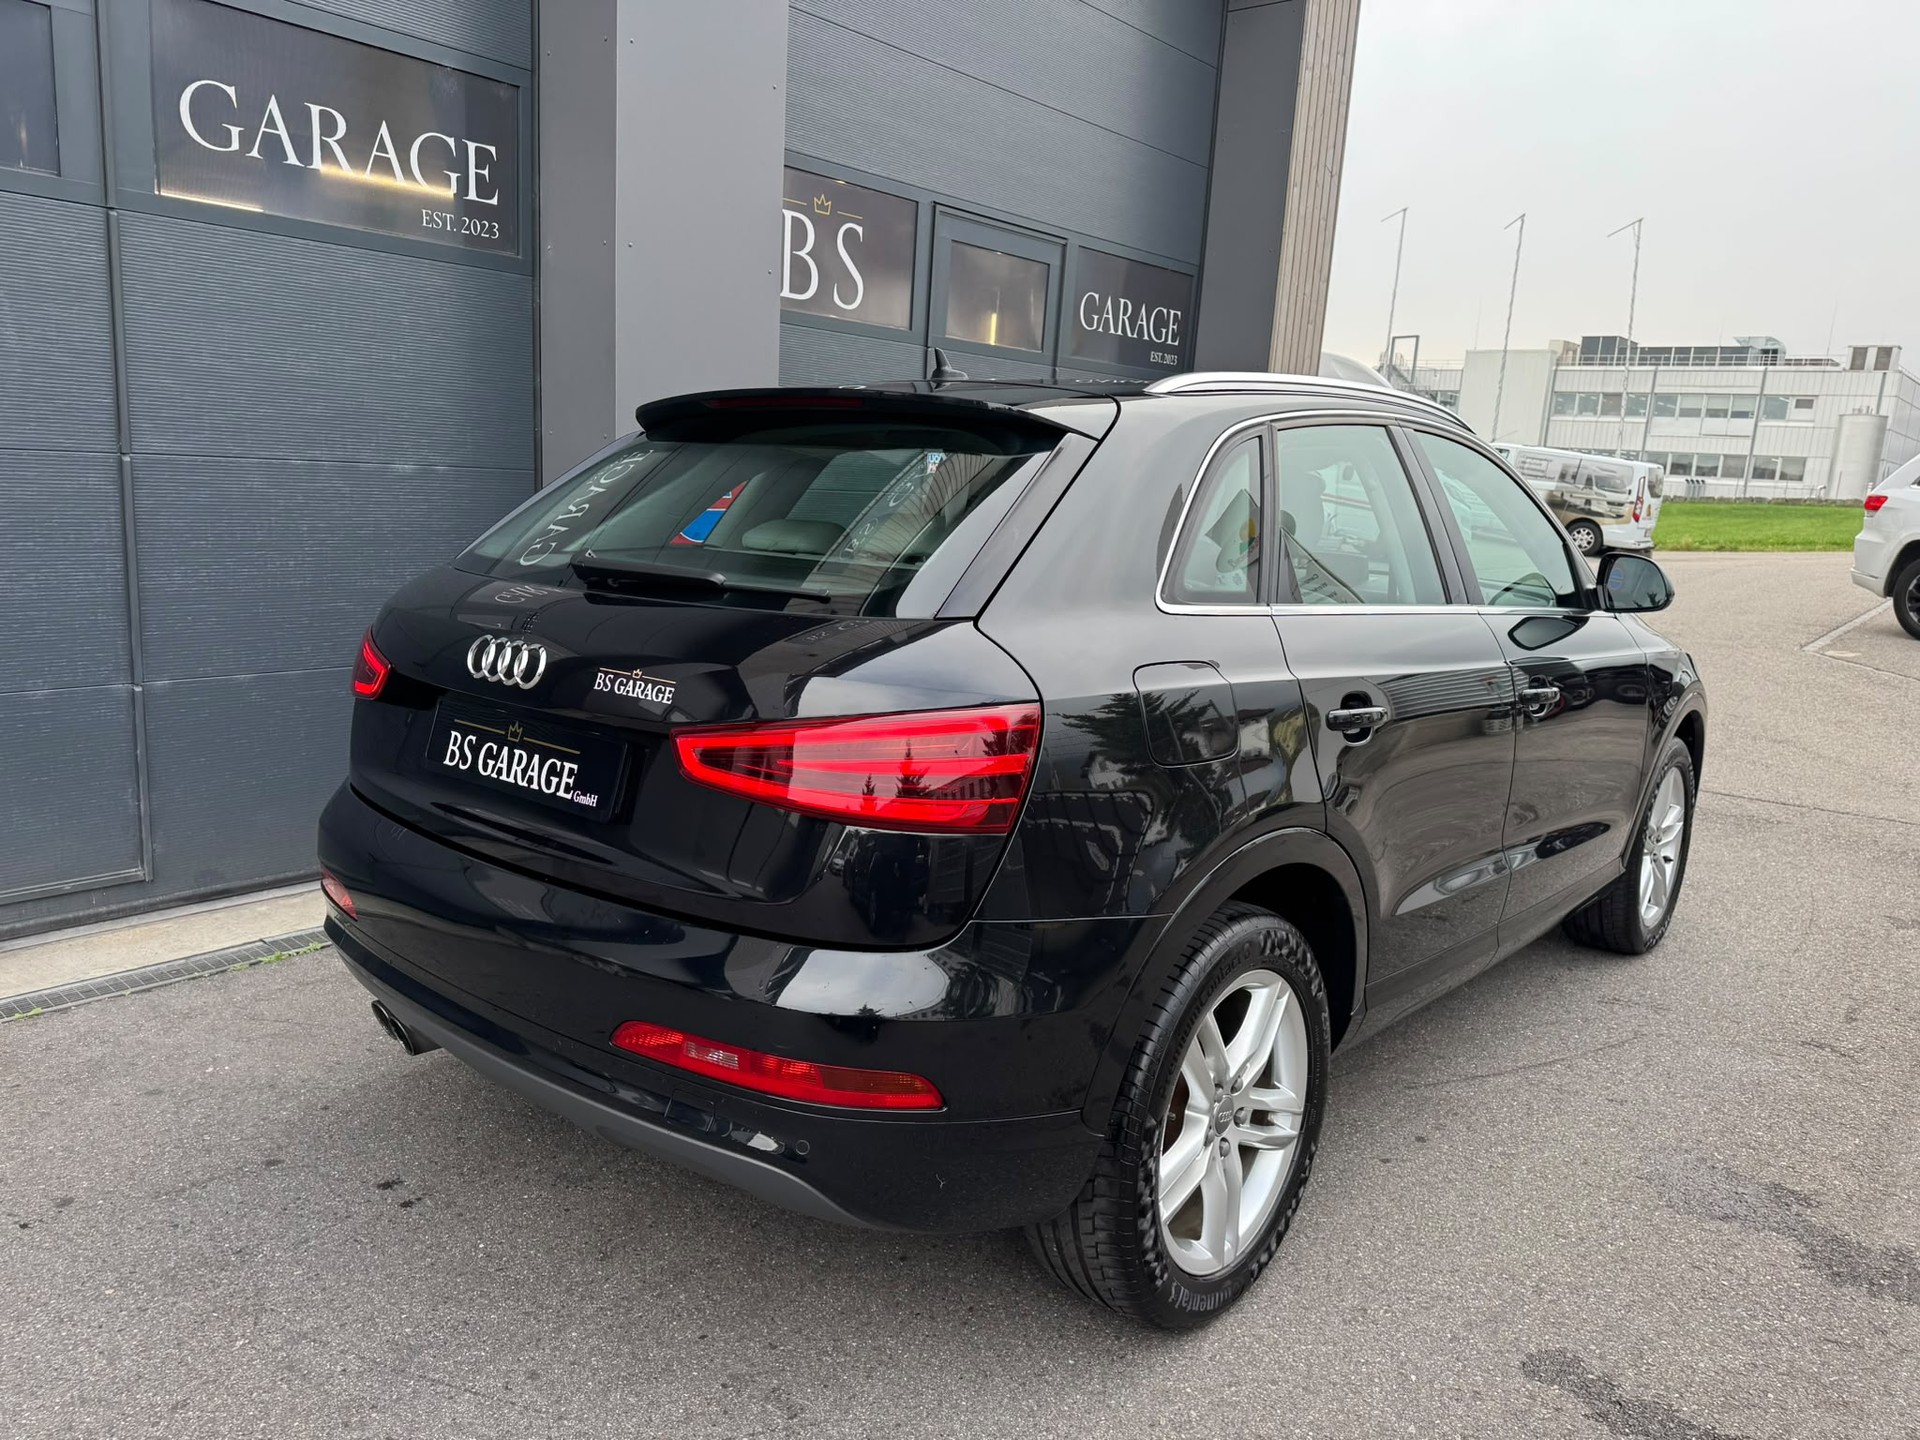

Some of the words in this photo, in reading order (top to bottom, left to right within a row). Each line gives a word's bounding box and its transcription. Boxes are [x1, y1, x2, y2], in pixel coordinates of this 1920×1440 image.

[179, 79, 500, 206] GARAGE
[421, 208, 457, 232] EST.
[460, 216, 500, 240] 2023
[780, 208, 864, 310] BS
[1079, 291, 1181, 346] GARAGE
[1150, 350, 1163, 363] EST.
[1163, 353, 1178, 366] 2023
[593, 672, 614, 692] BS
[614, 677, 676, 704] GARAGE
[442, 730, 477, 770] BS
[477, 742, 579, 800] GARAGE
[573, 790, 603, 808] GmbH
